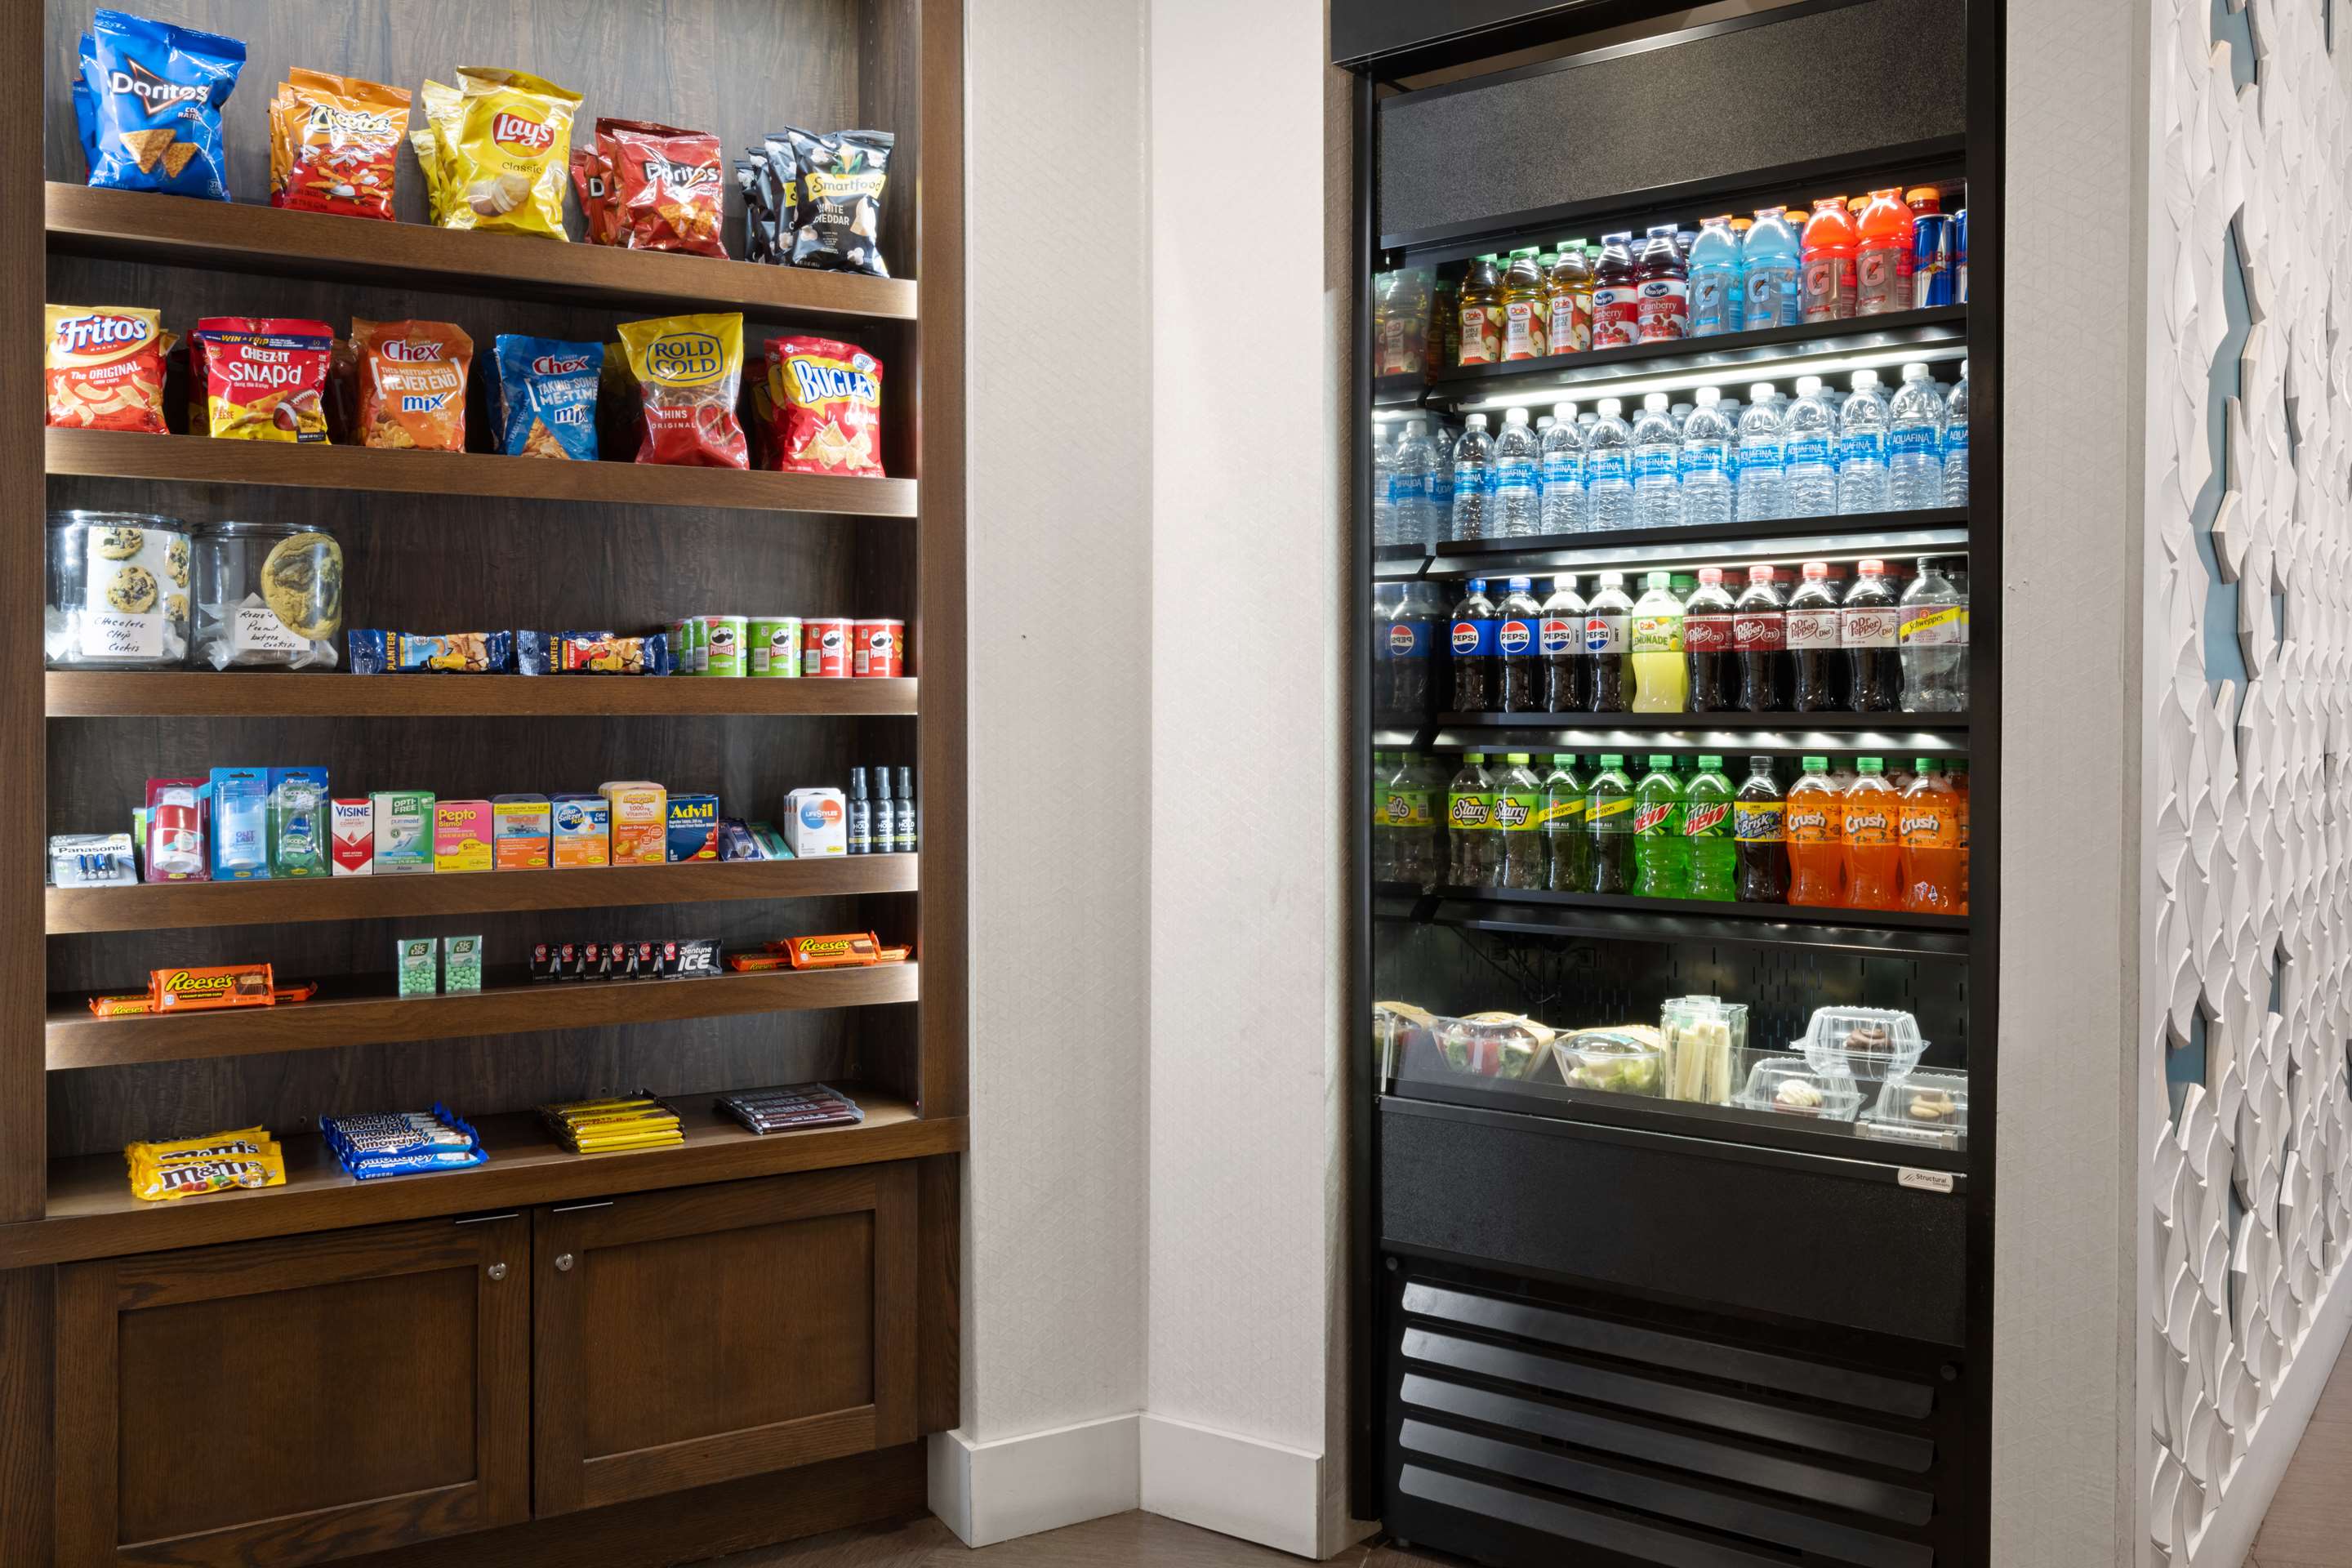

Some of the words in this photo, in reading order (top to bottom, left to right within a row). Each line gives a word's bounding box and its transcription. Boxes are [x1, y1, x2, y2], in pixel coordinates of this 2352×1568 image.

[111, 72, 210, 103] Doritos
[496, 113, 551, 146] Lay's
[501, 162, 542, 175] Classic
[644, 162, 719, 182] Doritos
[812, 176, 883, 194] Smartfood
[817, 203, 844, 214] WHITE
[1860, 254, 1886, 287] G
[1748, 271, 1770, 304] G
[1806, 264, 1831, 296] G
[1656, 286, 1668, 295] Spray
[1695, 276, 1719, 307] G
[1554, 300, 1570, 308] Dole
[1639, 301, 1677, 312] Cranberry
[55, 314, 147, 353] Fritos
[381, 339, 443, 363] Chex
[654, 341, 714, 359] ROLD
[71, 371, 87, 380] The
[89, 361, 142, 380] ORIGINAL
[399, 368, 432, 376] MEETING
[532, 354, 590, 375] Chex
[654, 357, 716, 376] GOLD
[382, 374, 430, 391] NEVER
[428, 372, 458, 390] END
[537, 380, 572, 394] TAKING
[573, 376, 599, 390] SOME
[792, 359, 875, 403] BUGLES
[403, 392, 448, 413] mix
[555, 404, 590, 425] mix
[659, 410, 688, 419] THINS
[1892, 432, 1930, 444] AQUAFINA
[1949, 430, 1968, 441] AQUA
[1788, 443, 1822, 456] AQUAFINA
[1640, 621, 1655, 630] Dole
[1742, 621, 1754, 630] Dr
[1796, 619, 1808, 628] Dr
[1849, 620, 1879, 637] Pepper
[1857, 616, 1869, 626] Dr
[1909, 614, 1944, 631] Schweppes
[1586, 630, 1608, 639] PEPSI
[1687, 629, 1709, 643] Pepper
[1736, 624, 1762, 641] Pepper
[1789, 621, 1816, 639] Pepper
[1818, 629, 1831, 637] Diet
[1881, 626, 1893, 635] Diet
[386, 631, 396, 671] PLANTERS
[550, 635, 559, 673] PLANTERS
[710, 644, 735, 657] PRINGLES
[394, 798, 417, 807] OPTI-
[394, 804, 416, 813] FREE
[670, 803, 713, 818] Advil
[1452, 797, 1490, 824] Starry
[1494, 797, 1529, 823] Starry
[335, 806, 371, 817] VISINE
[438, 808, 477, 822] Pepto
[1788, 812, 1825, 832] Crush
[1846, 812, 1886, 834] Crush
[1900, 814, 1939, 834] Crush
[58, 844, 127, 854] Panasonic
[679, 946, 712, 956] Dentyne
[800, 938, 849, 953] Reese's
[678, 954, 711, 971] ICE
[164, 971, 236, 992] Reese's
[1915, 1173, 1947, 1183] Structural
